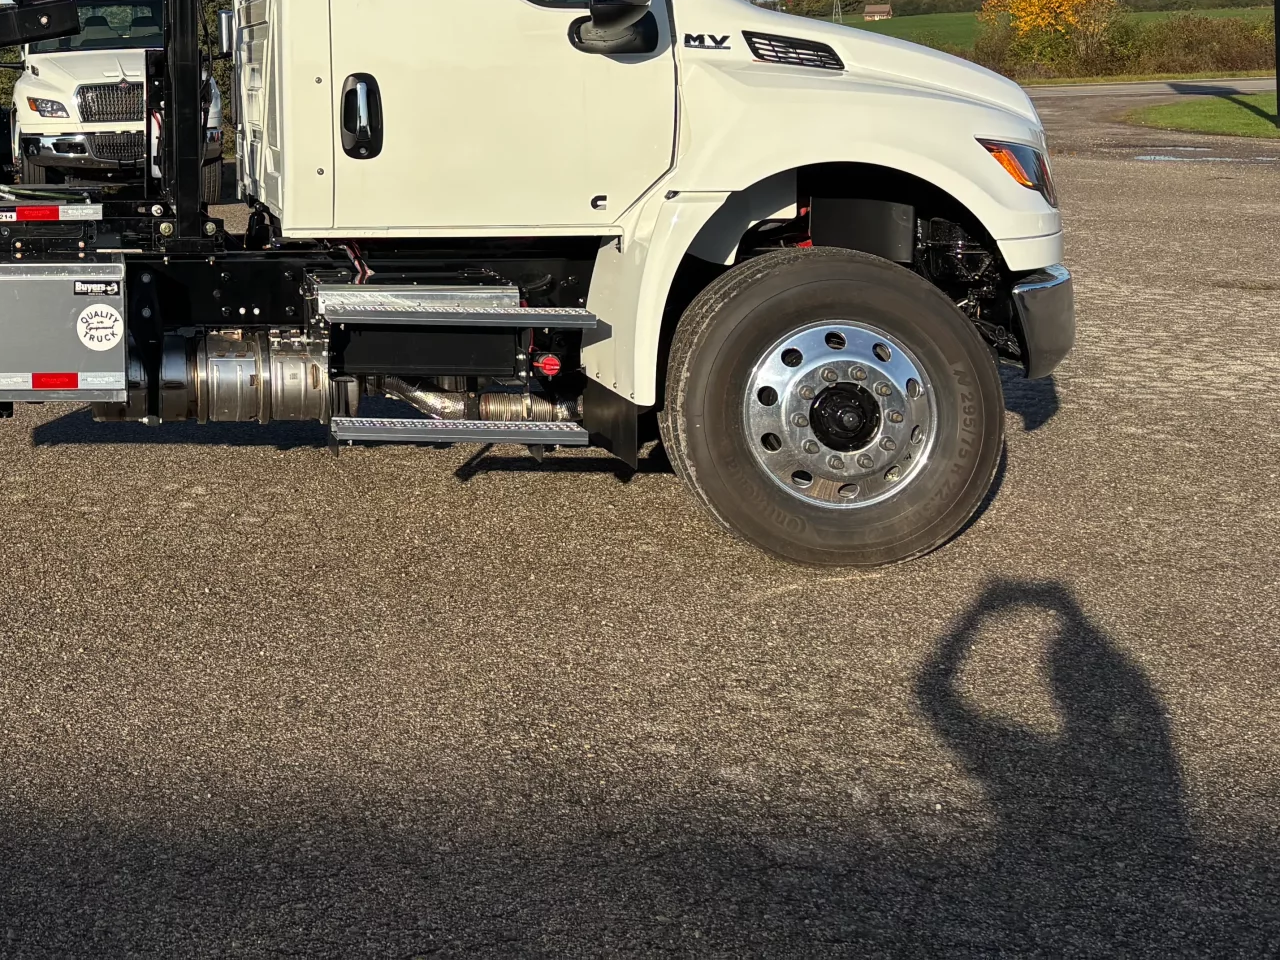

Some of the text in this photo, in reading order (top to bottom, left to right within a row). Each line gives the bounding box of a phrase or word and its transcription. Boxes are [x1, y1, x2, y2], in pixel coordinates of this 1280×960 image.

[684, 33, 730, 46] MV
[75, 281, 106, 293] Buyers
[81, 311, 119, 324] QUALITY
[83, 330, 118, 343] TRUCK
